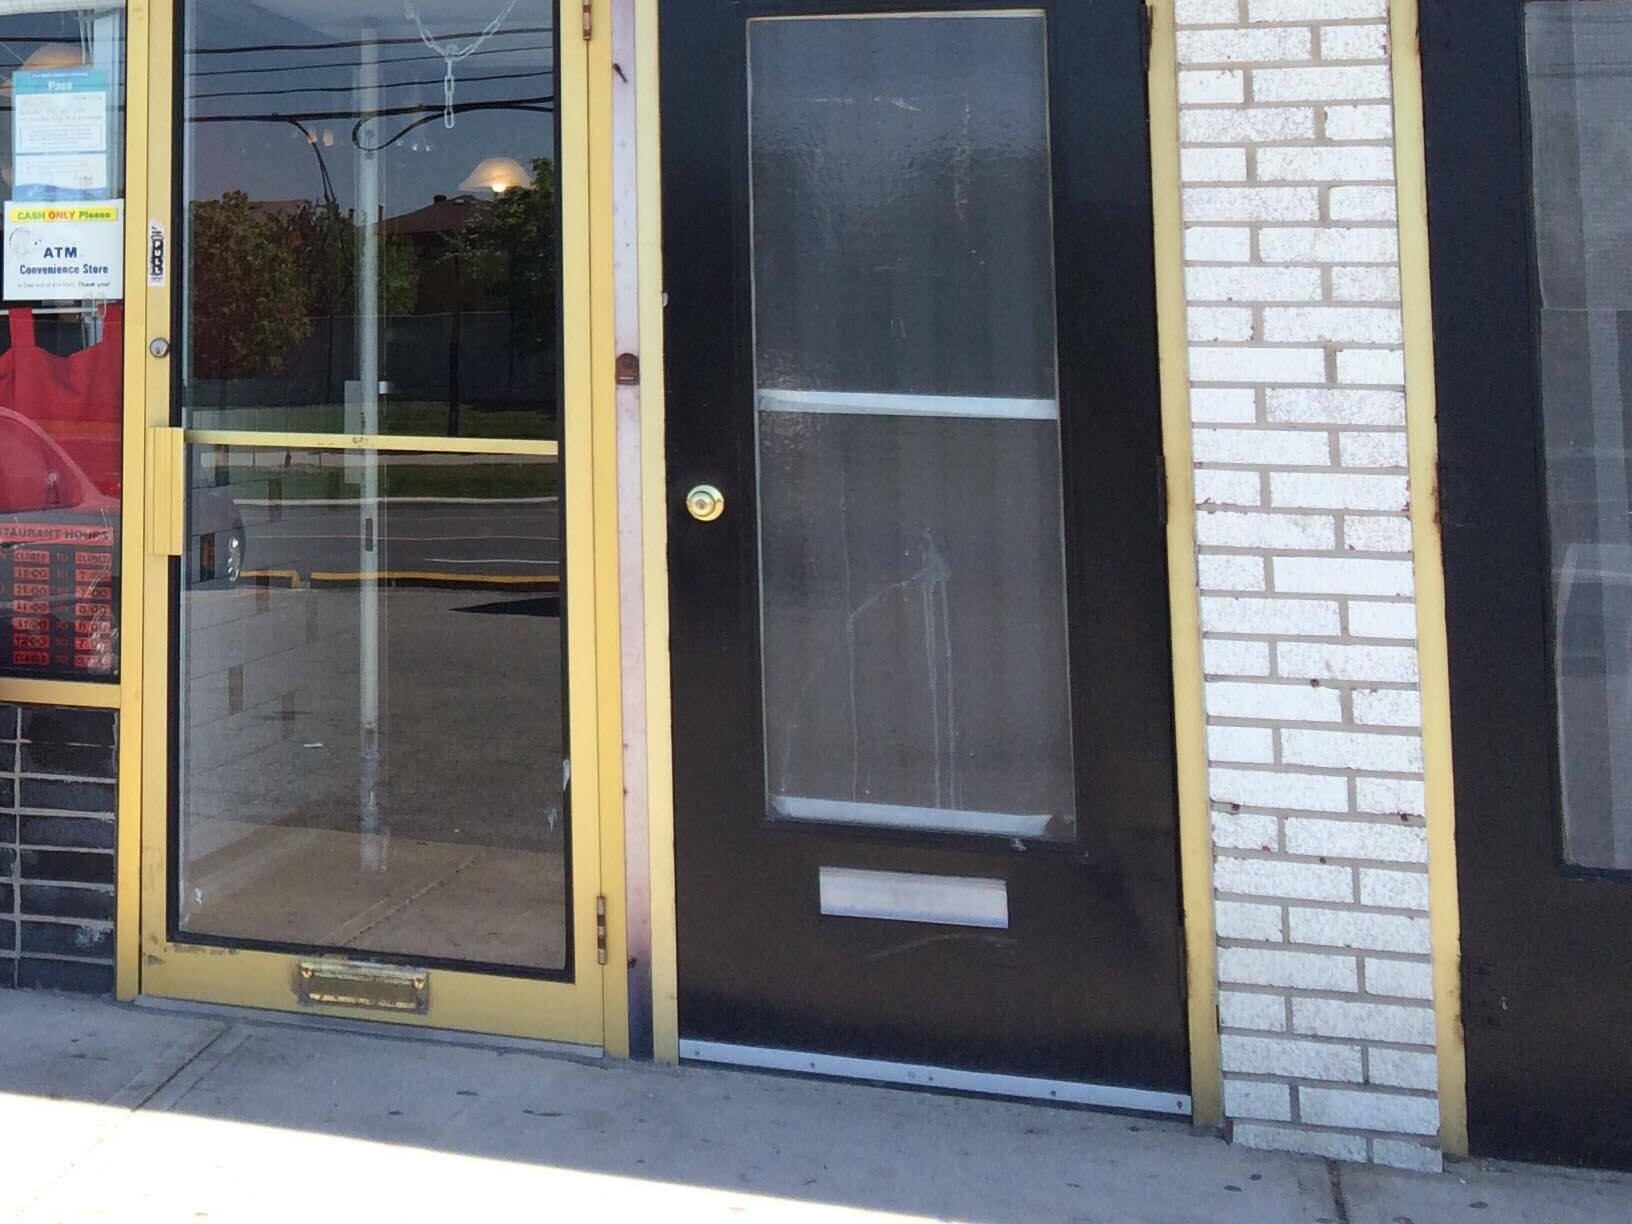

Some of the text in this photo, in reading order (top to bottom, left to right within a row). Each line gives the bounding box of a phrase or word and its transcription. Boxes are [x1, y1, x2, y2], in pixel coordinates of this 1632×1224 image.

[17, 210, 112, 221] CASH ONLY Please
[43, 246, 78, 259] ATM
[19, 263, 109, 275] Convenience Store
[64, 528, 109, 540] HOURS
